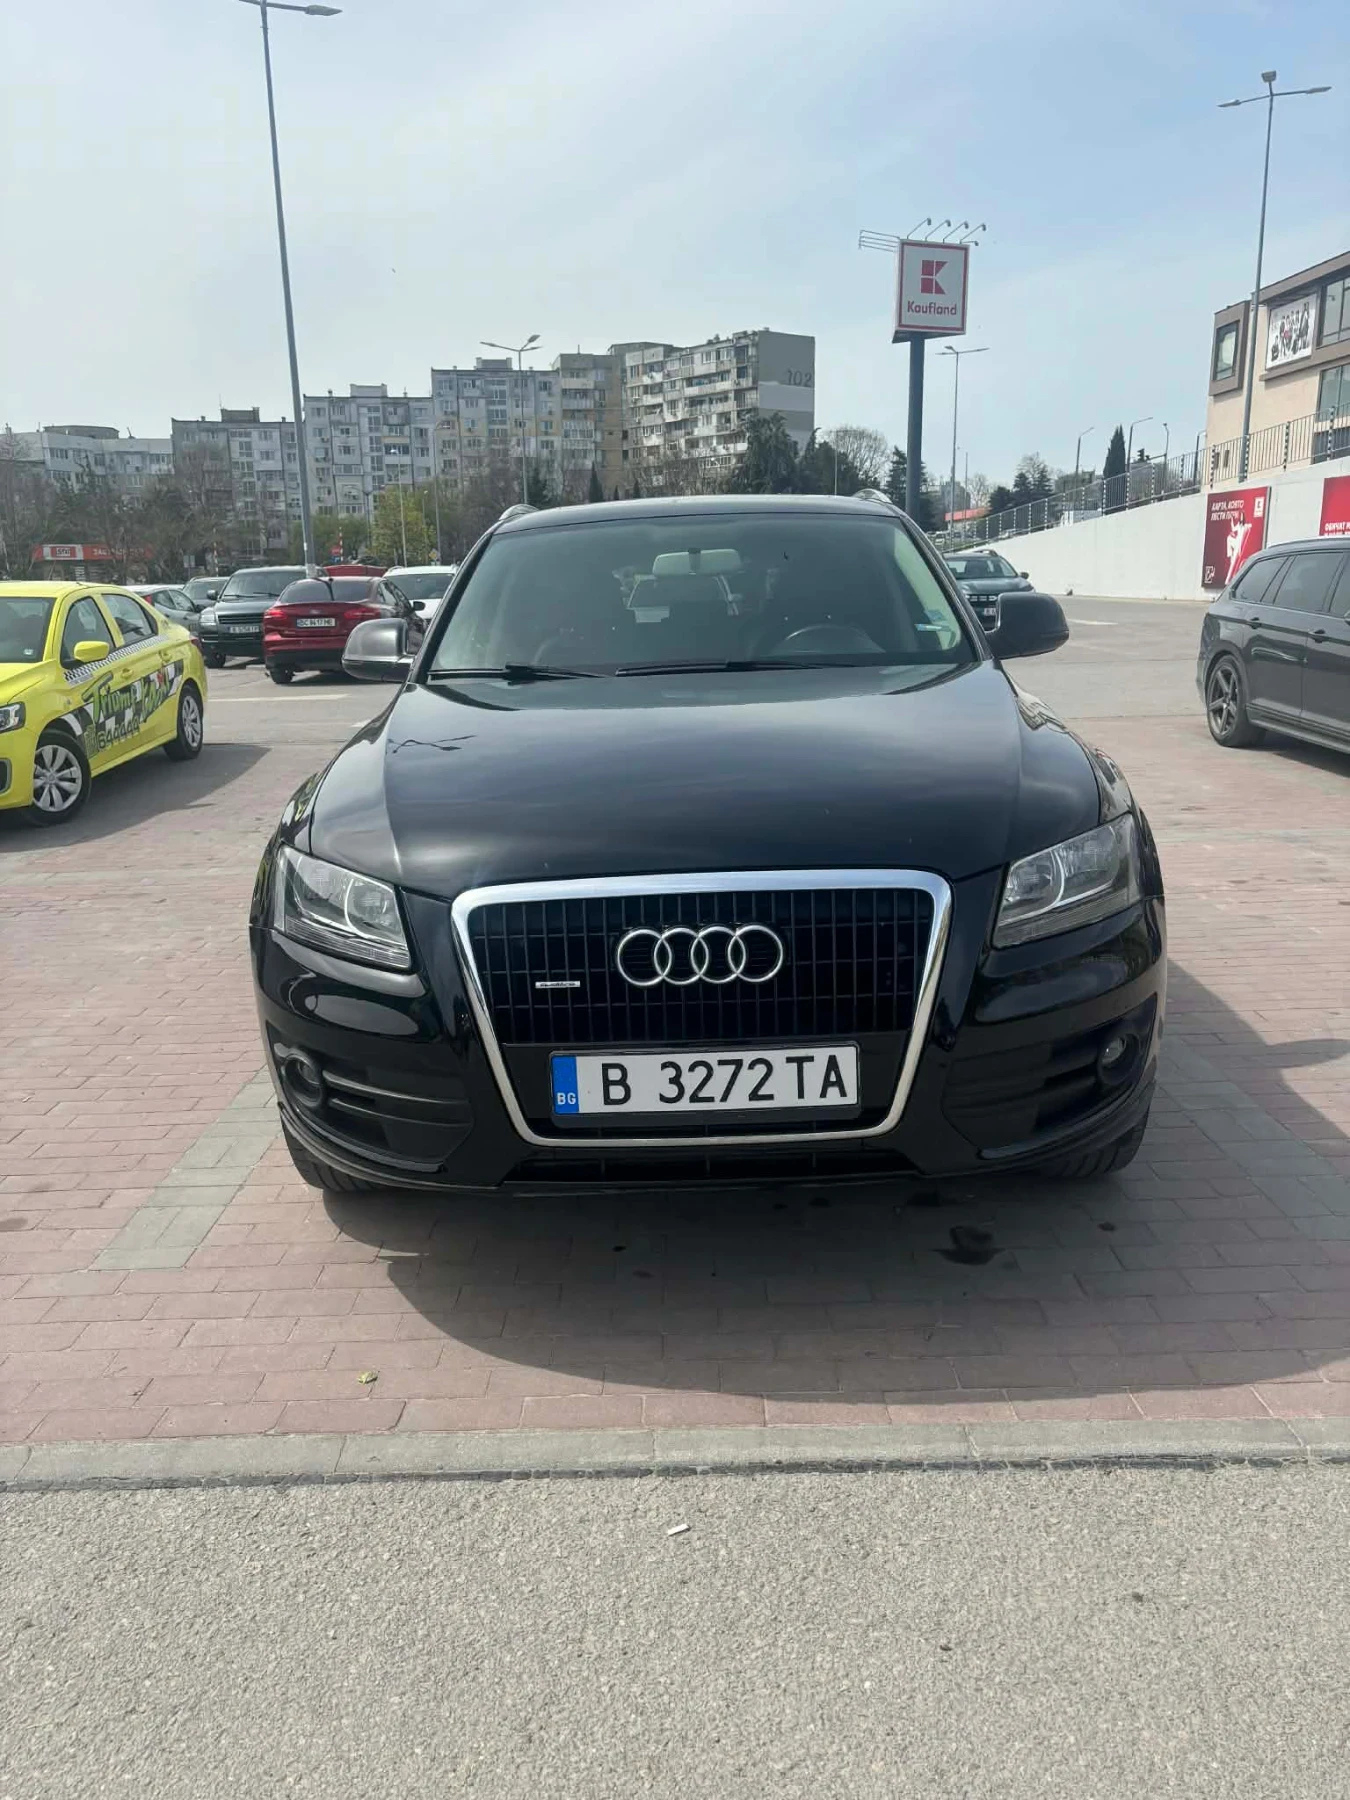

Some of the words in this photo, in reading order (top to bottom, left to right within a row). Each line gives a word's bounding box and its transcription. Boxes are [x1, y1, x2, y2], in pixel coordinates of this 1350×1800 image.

[907, 301, 957, 316] Kaufland
[787, 369, 812, 388] 102
[601, 1062, 632, 1106] B
[556, 1092, 577, 1105] BG
